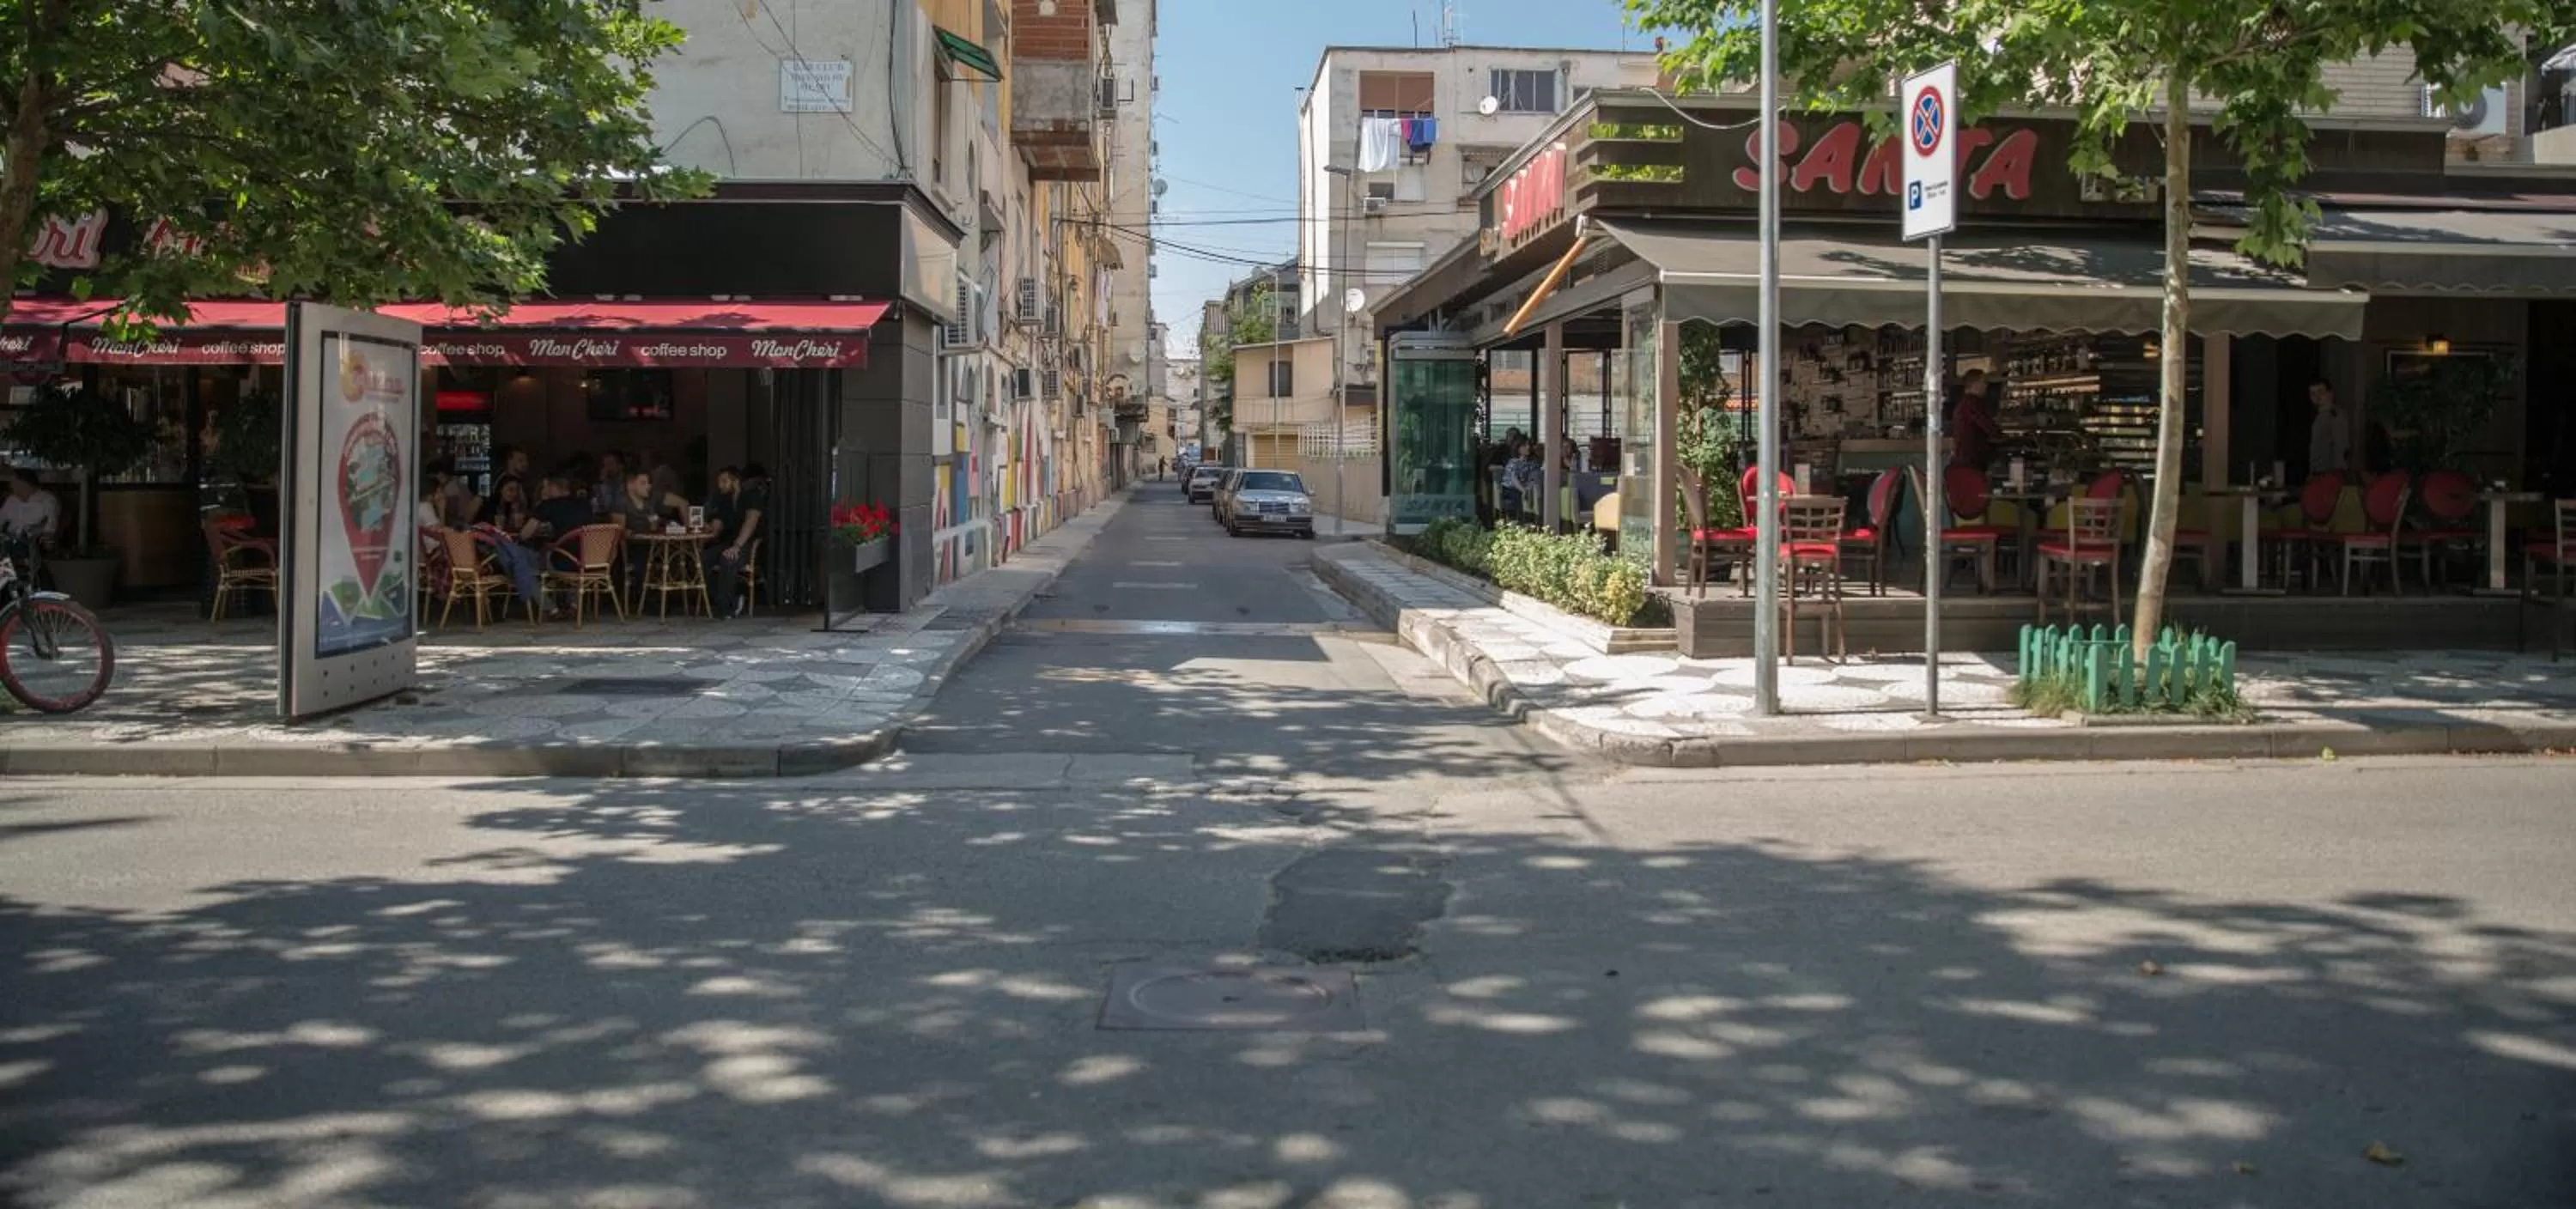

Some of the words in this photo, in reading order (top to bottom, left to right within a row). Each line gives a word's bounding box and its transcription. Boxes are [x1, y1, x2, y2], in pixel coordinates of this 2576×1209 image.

[202, 340, 248, 355] coffee
[250, 341, 286, 357] shop
[419, 342, 466, 356] coffee
[466, 343, 505, 358] shop
[641, 343, 687, 357] coffee
[689, 343, 727, 359] shop
